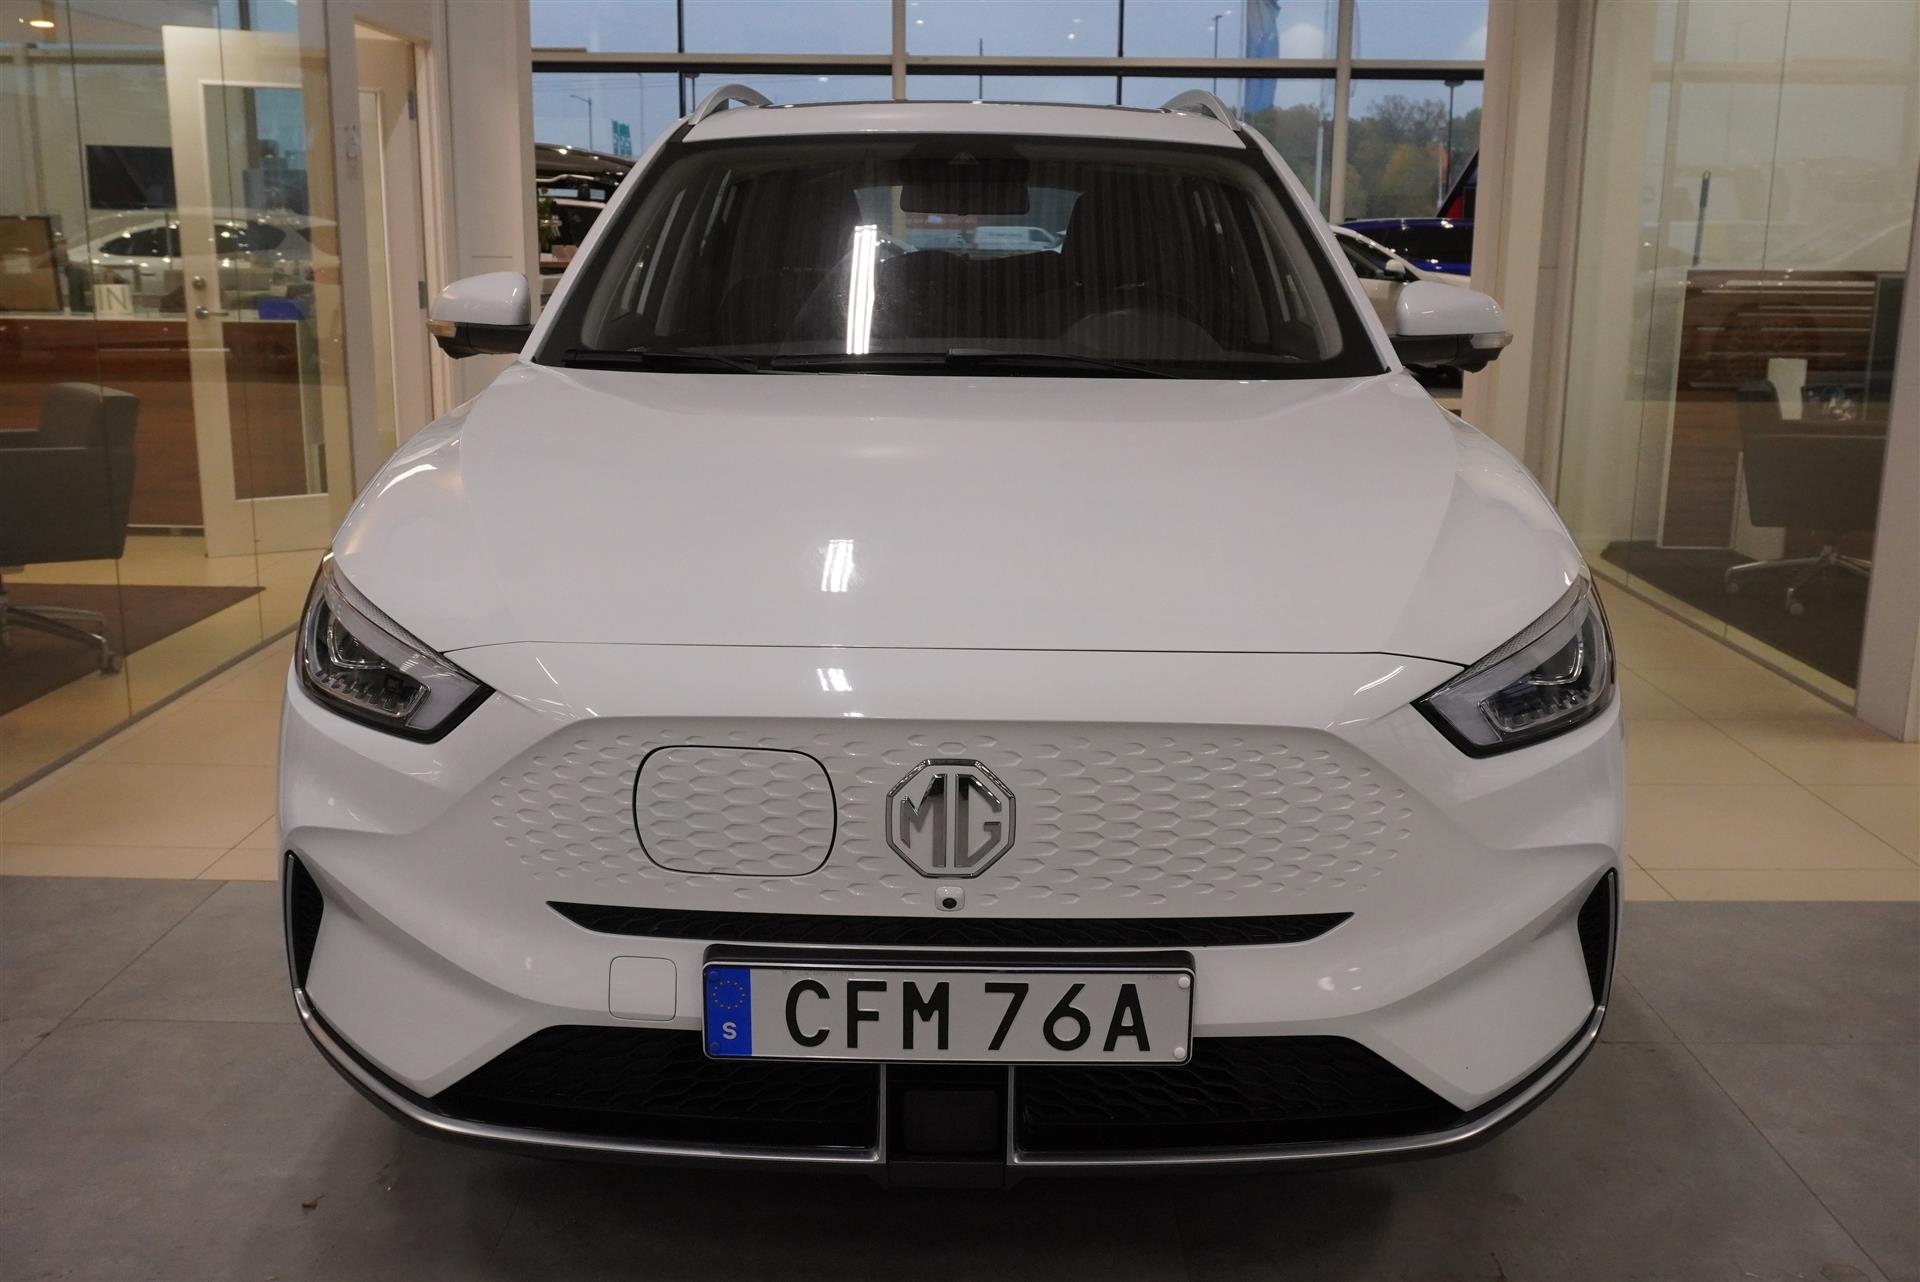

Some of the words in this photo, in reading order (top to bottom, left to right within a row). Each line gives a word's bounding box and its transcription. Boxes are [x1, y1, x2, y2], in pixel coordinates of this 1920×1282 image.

[900, 773, 1002, 868] MG
[722, 1021, 737, 1040] S
[785, 978, 950, 1051] CFM
[984, 981, 1151, 1053] 76A
